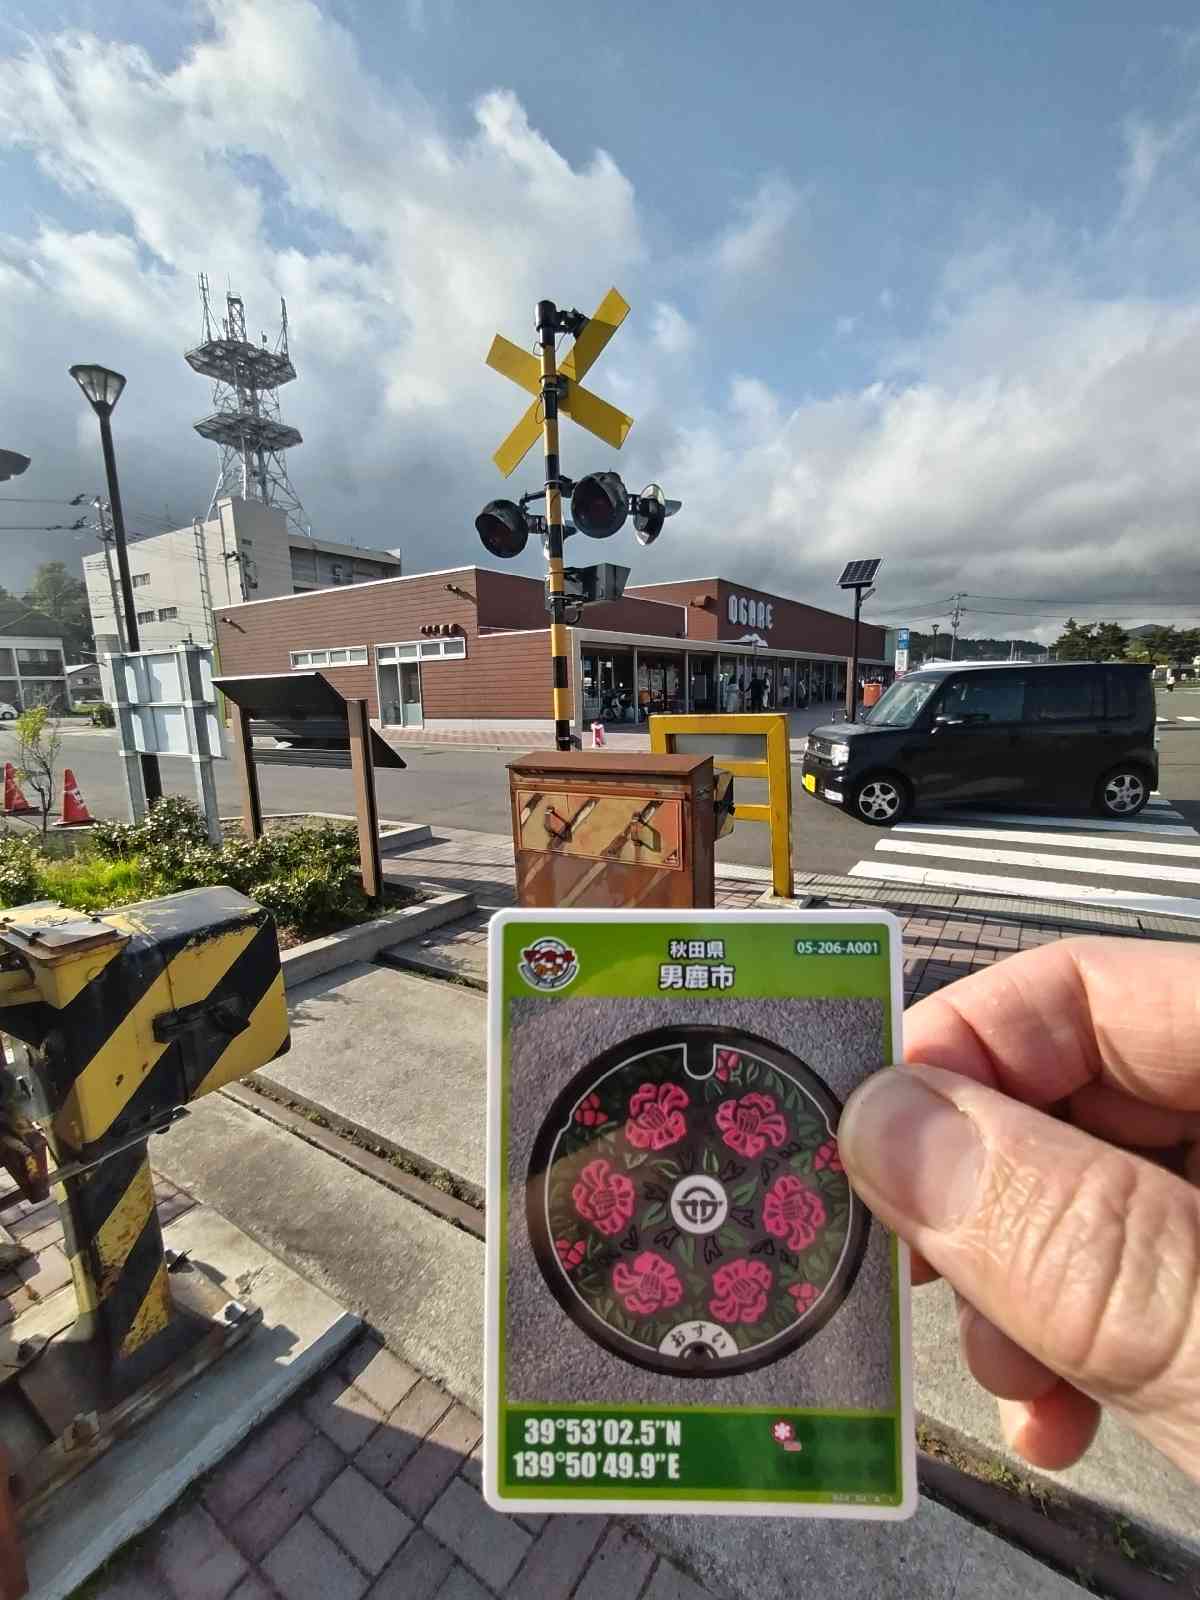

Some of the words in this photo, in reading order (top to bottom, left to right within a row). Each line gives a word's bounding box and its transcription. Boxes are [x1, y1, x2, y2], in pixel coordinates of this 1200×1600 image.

[728, 594, 773, 629] OGARE
[670, 940, 724, 959] 秋田県
[797, 941, 878, 954] 05-206-A001
[660, 964, 734, 989] 男鹿市
[671, 1323, 726, 1349] おすい
